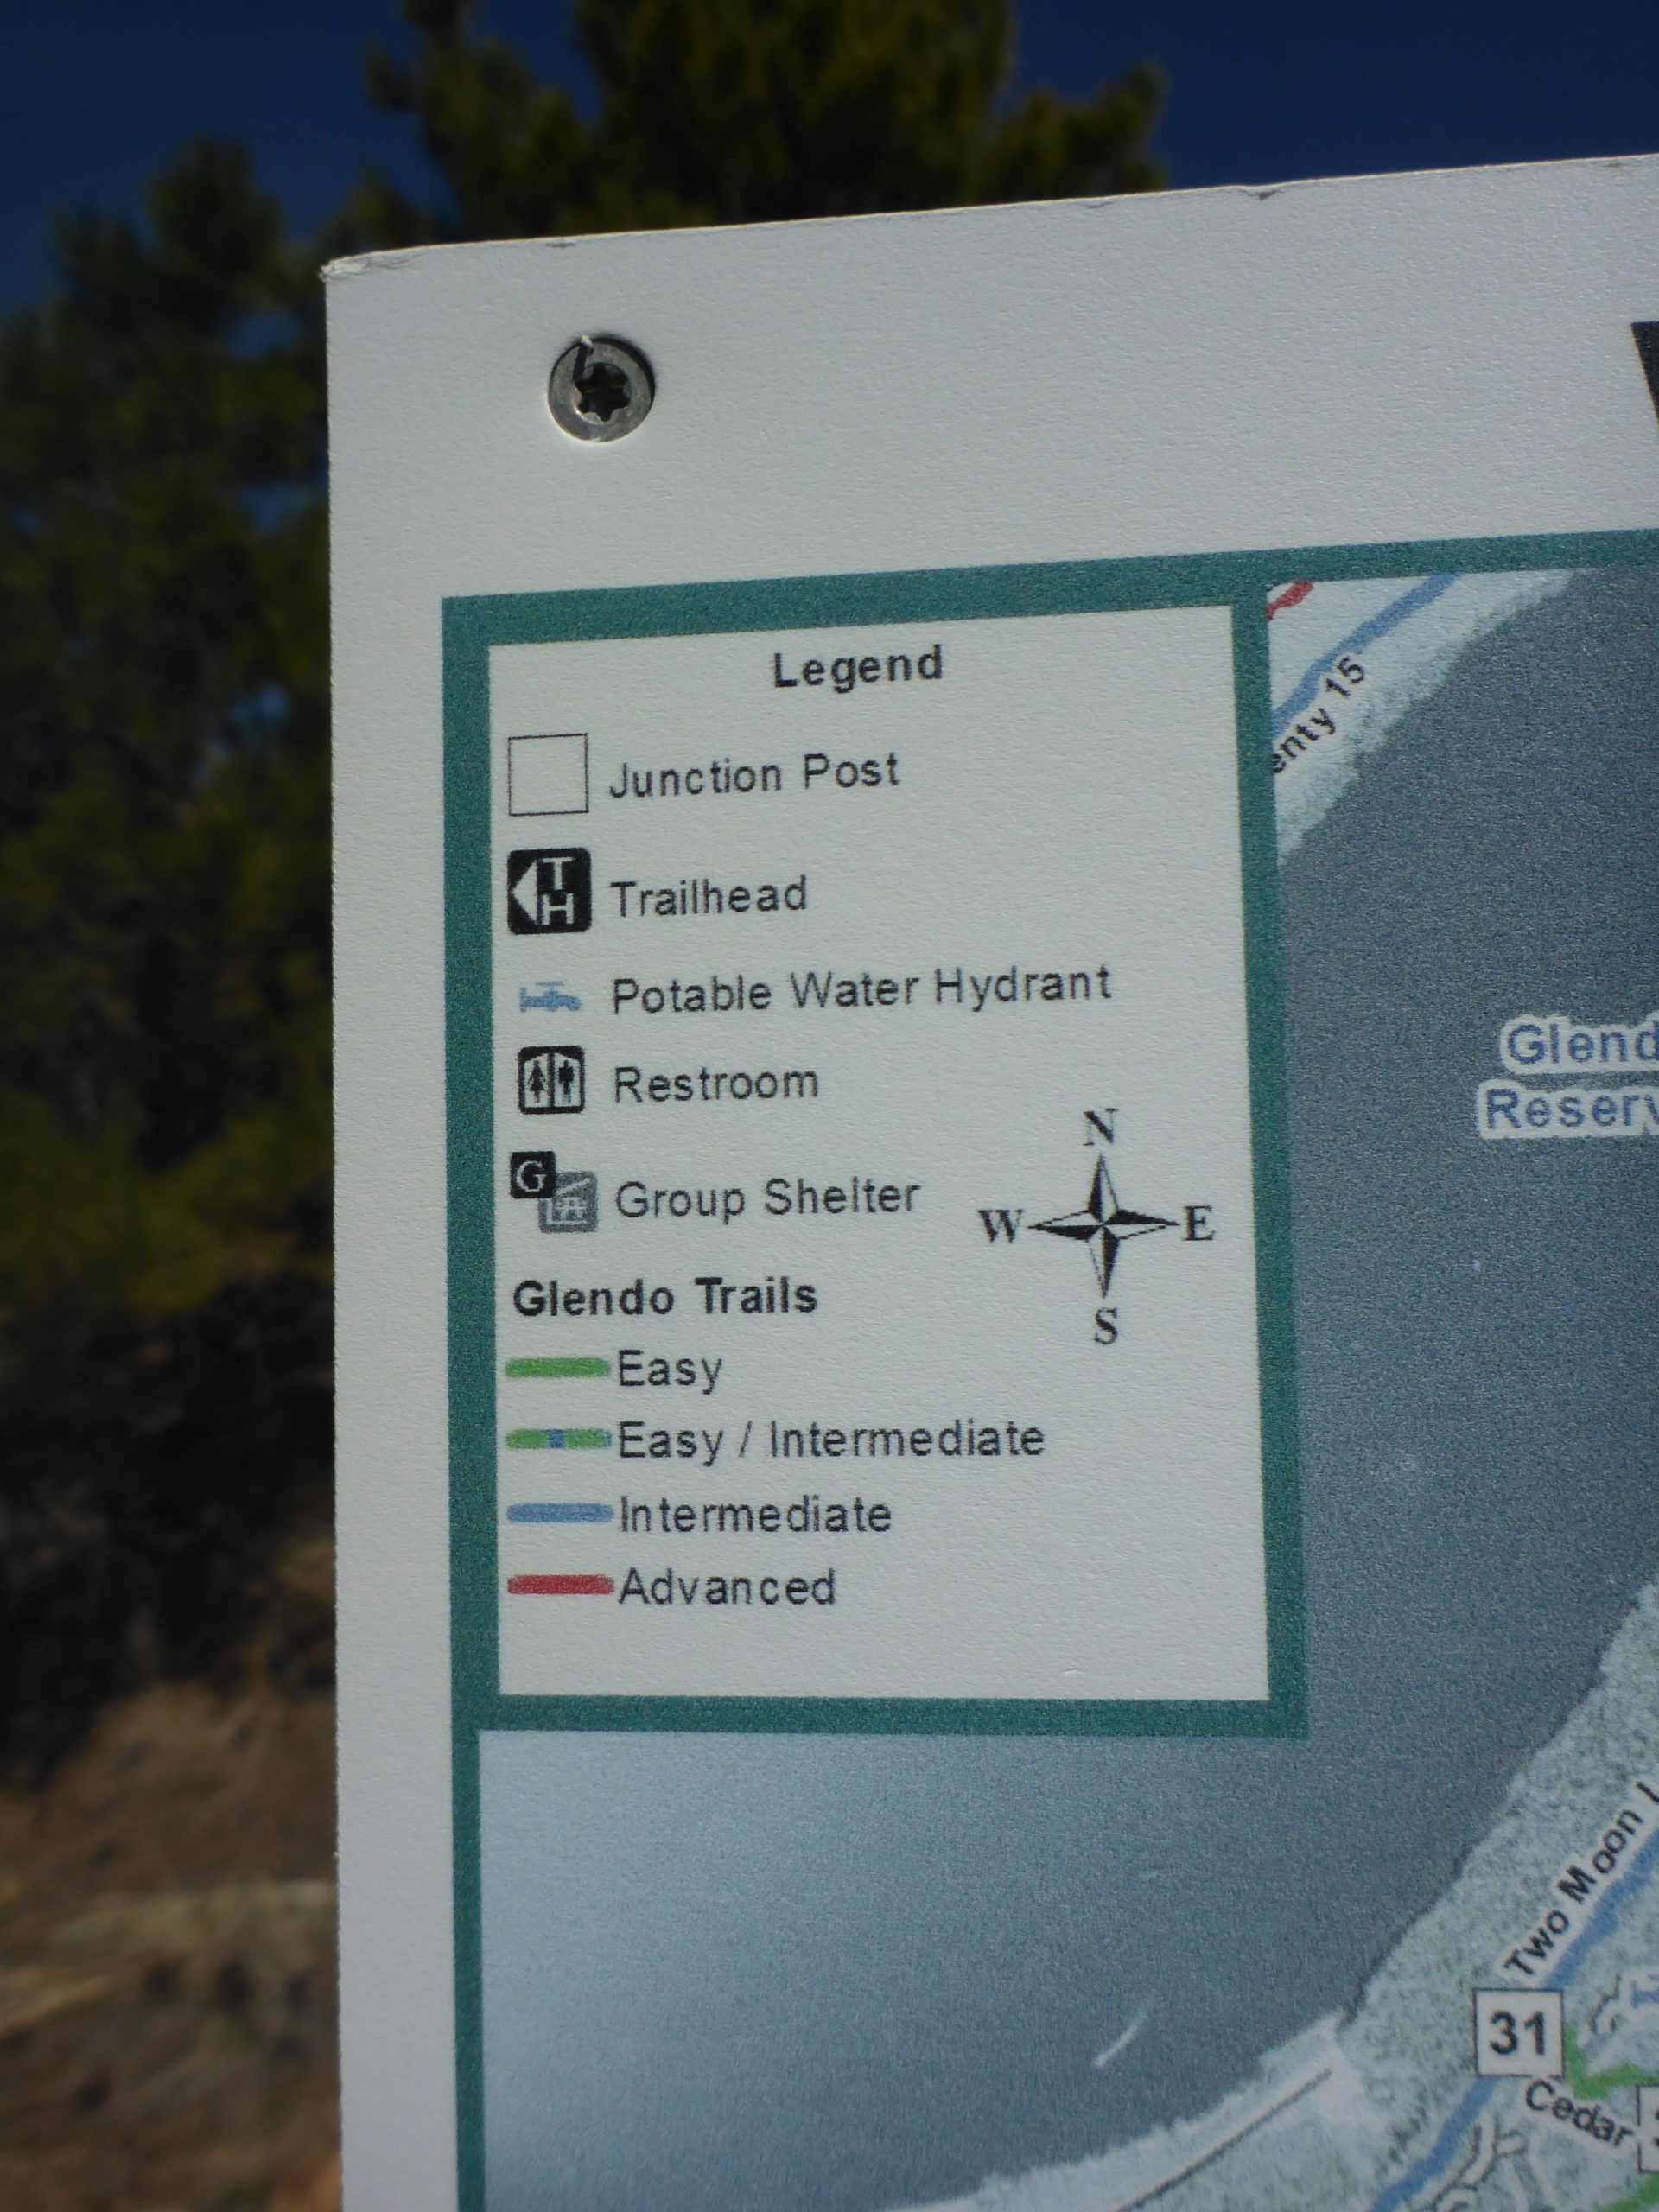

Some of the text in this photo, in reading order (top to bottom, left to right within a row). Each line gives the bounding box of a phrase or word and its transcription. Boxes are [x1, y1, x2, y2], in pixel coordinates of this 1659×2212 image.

[772, 643, 944, 694] Legend
[1325, 655, 1364, 696] 15
[608, 752, 900, 799] Junction Post
[608, 874, 807, 918] Trailhead
[611, 963, 1112, 1015] Potable Water Hydrant
[614, 1065, 819, 1103] Restroom
[1083, 1107, 1119, 1147] N
[516, 1160, 547, 1192] G
[614, 1176, 921, 1225] Group Shelter
[977, 1208, 1025, 1244] W
[1182, 1204, 1216, 1242] E
[512, 1275, 819, 1317] Glendo Trails
[1093, 1307, 1119, 1345] S
[618, 1348, 723, 1396] Easy
[618, 1418, 1046, 1468] Easy / Intermediate
[620, 1494, 893, 1534] Intermediate
[617, 1567, 836, 1606] Advanced
[1503, 1809, 1644, 1975] Two Moon
[1489, 2010, 1547, 2057] 31
[1525, 2078, 1635, 2148] Cedar
